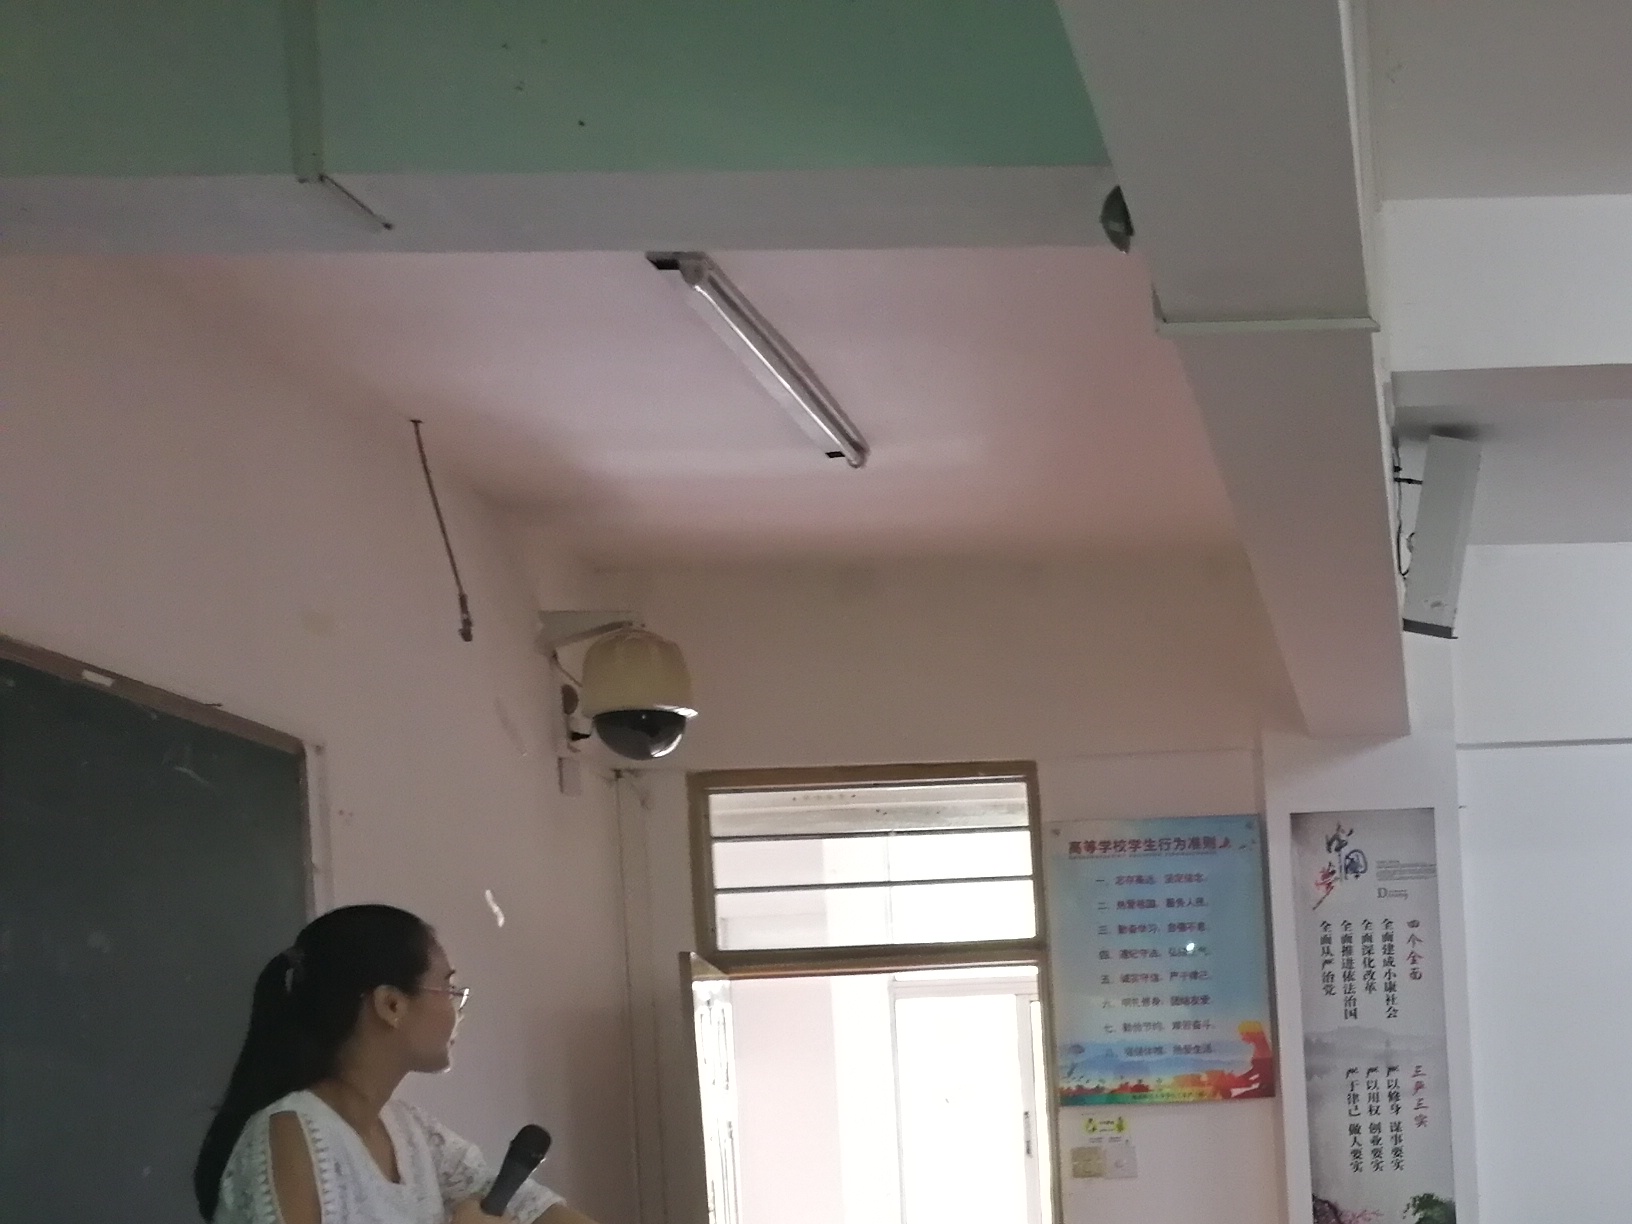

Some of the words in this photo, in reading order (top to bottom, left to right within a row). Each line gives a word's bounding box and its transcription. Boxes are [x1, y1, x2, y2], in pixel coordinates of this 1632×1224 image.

[1068, 835, 1217, 855] 高等学校学生行为准则
[1320, 920, 1337, 996] 全面从严治党
[1340, 919, 1358, 1020] 全面推进依法治国
[1361, 918, 1377, 994] 全面深化改革
[1381, 918, 1399, 1019] 全面建成小康社会
[1406, 919, 1424, 980] 四个全面
[1345, 1066, 1361, 1117] 严于律己
[1366, 1066, 1381, 1116] 严以用权
[1386, 1065, 1402, 1115] 严以修身
[1411, 1065, 1429, 1128] 三严三实
[1368, 1122, 1384, 1172] 创业要实
[1389, 1121, 1404, 1171] 谋事要实
